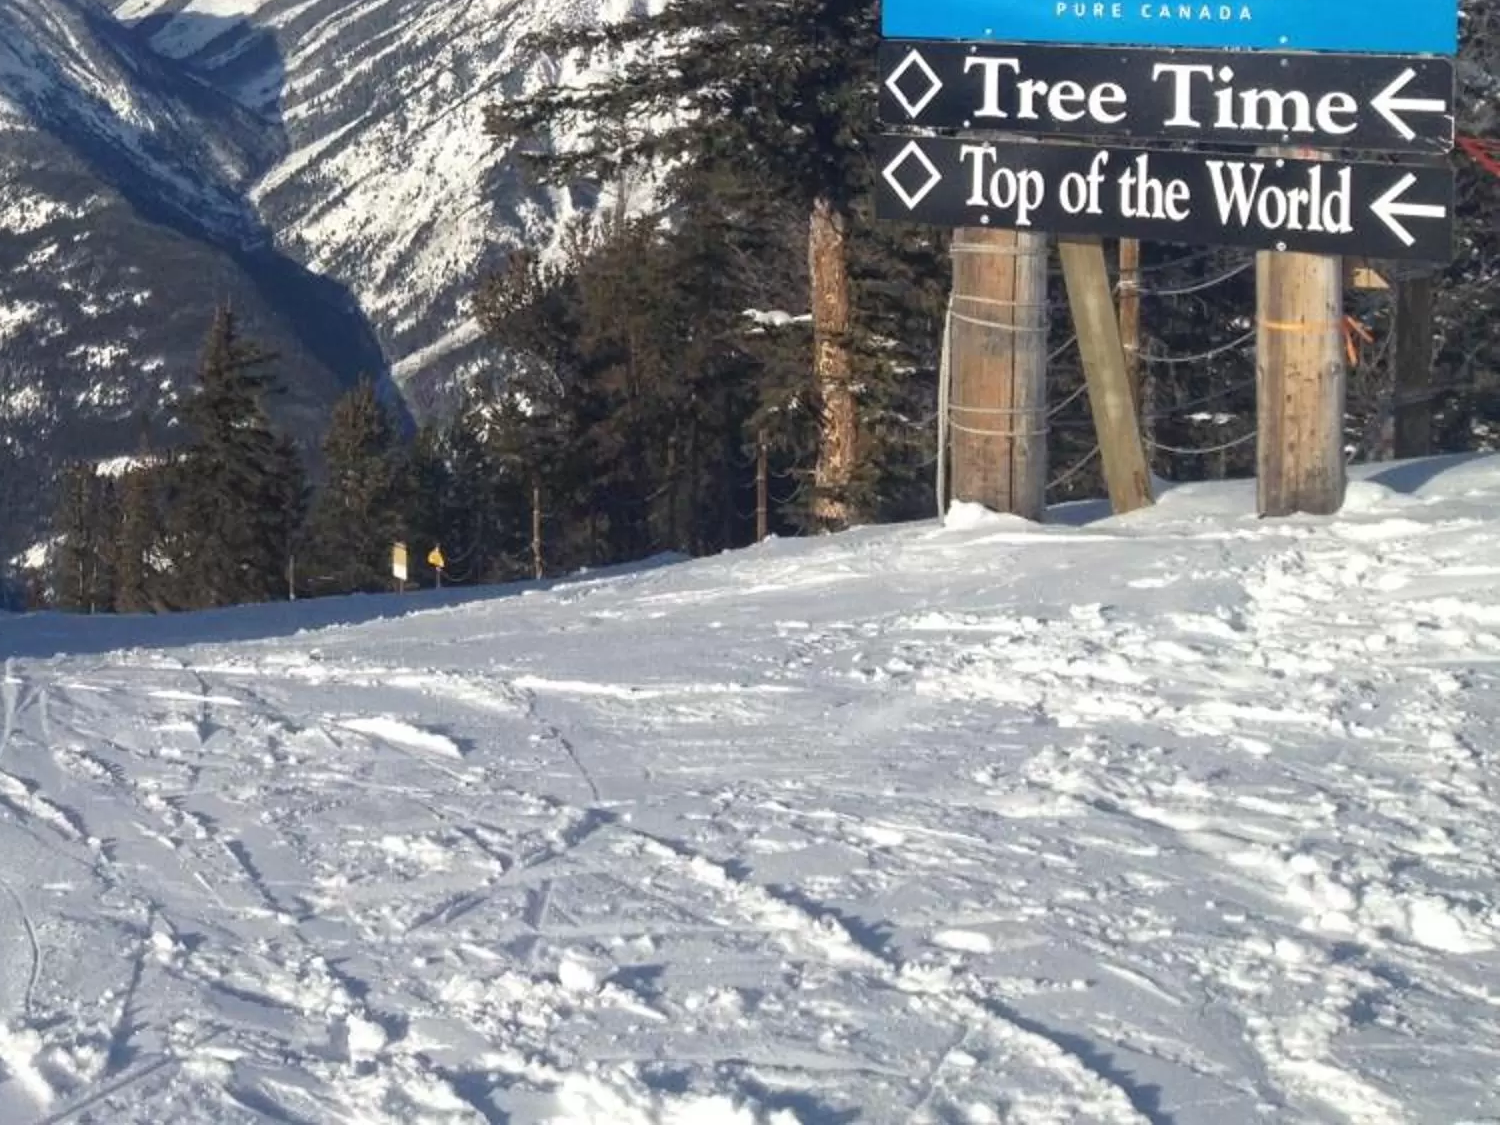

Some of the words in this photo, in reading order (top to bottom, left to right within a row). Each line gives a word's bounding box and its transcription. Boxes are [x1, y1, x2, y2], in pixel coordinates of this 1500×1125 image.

[1056, 2, 1123, 19] PURE
[1141, 3, 1253, 21] CANADA
[963, 56, 1127, 124] Tree
[1152, 63, 1358, 134] Time
[960, 145, 1046, 225] Top
[1058, 151, 1109, 215] of
[1119, 153, 1190, 219] the
[1206, 161, 1353, 233] World
